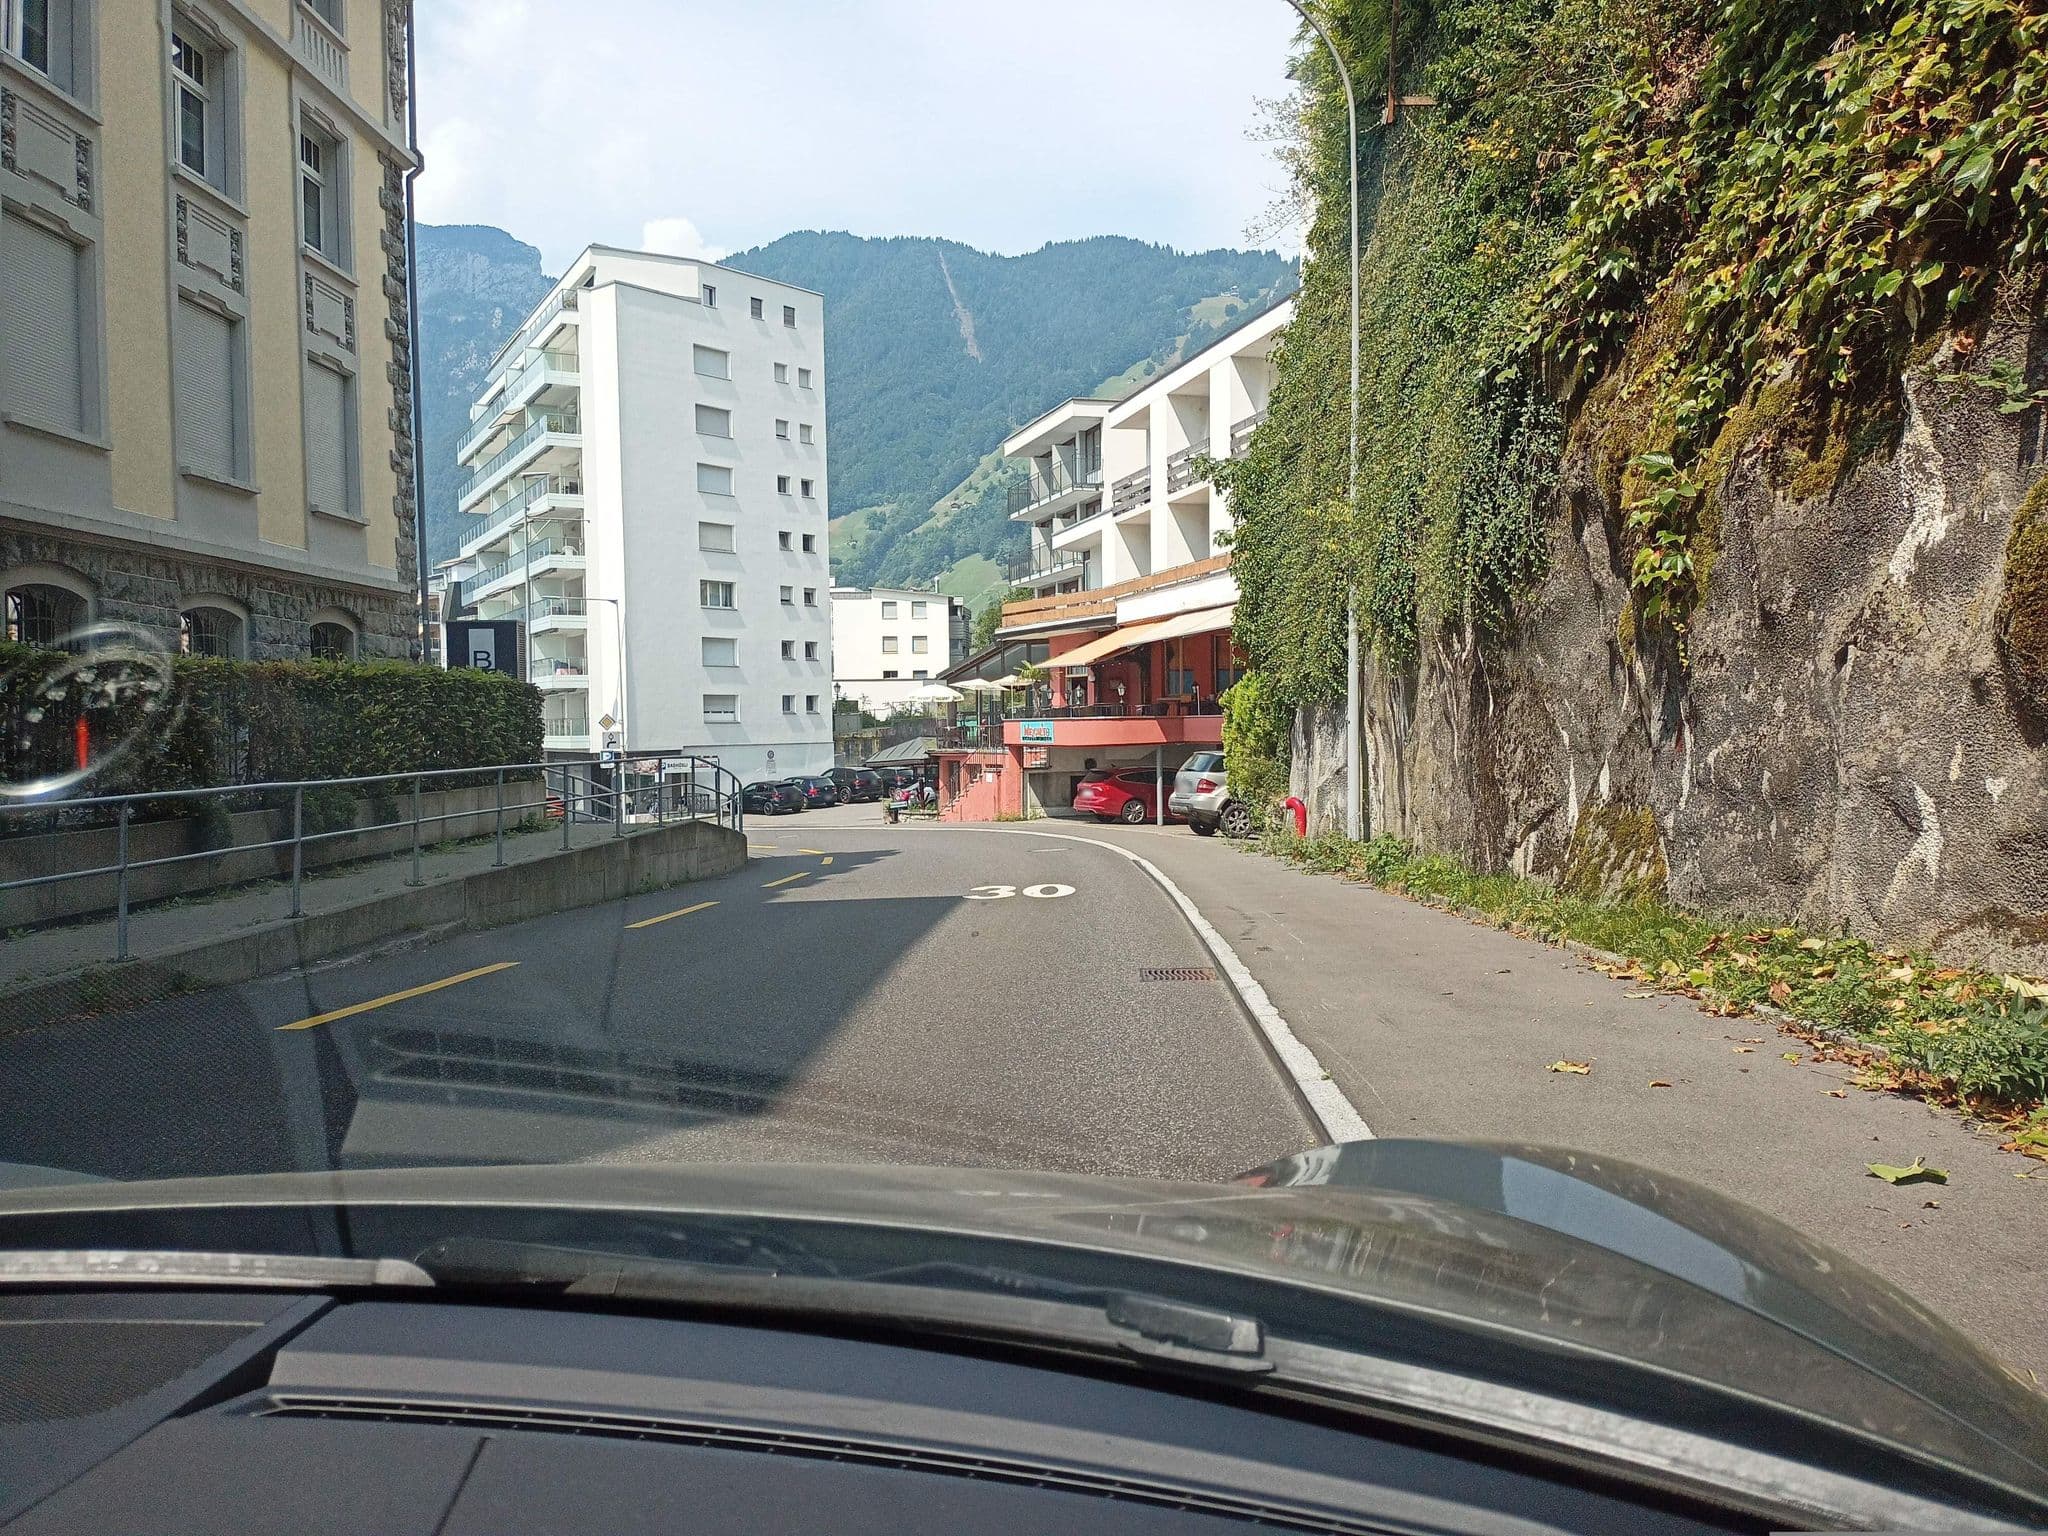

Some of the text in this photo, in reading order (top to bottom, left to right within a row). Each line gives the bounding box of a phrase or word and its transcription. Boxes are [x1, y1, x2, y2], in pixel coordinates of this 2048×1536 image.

[474, 651, 491, 669] B
[602, 751, 612, 761] P
[962, 883, 1076, 899] 30
